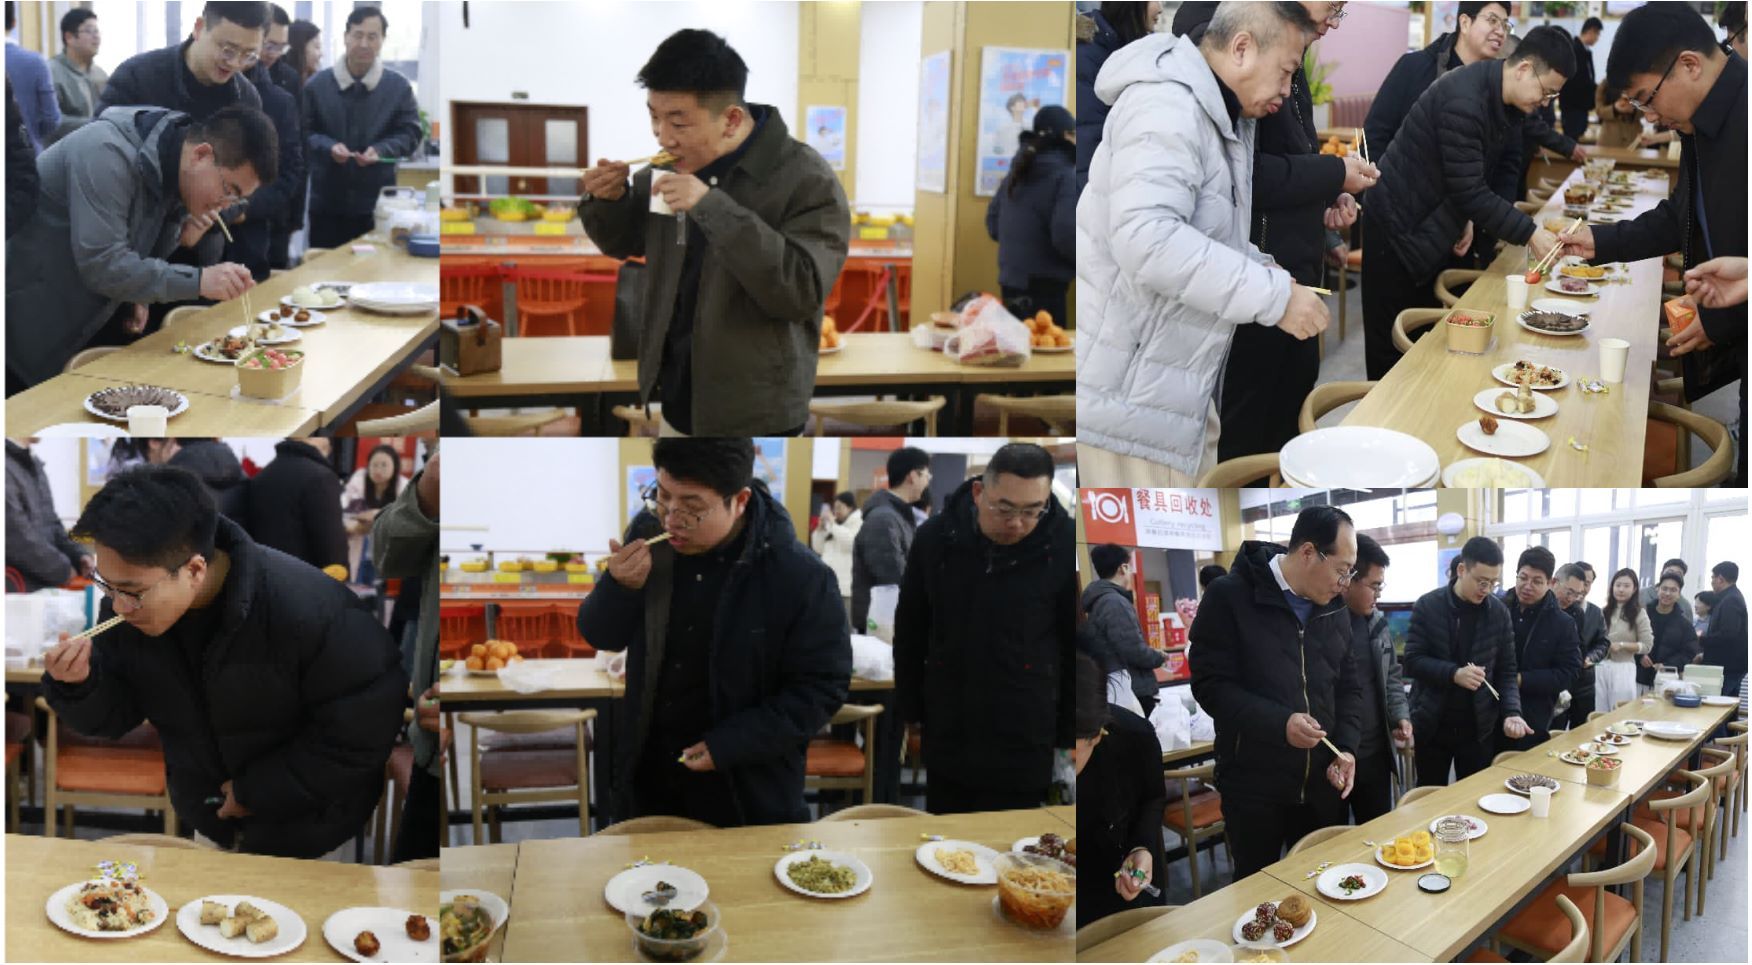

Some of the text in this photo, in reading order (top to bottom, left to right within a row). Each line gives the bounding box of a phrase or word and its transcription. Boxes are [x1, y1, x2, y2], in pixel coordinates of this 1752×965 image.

[1137, 488, 1212, 517] 餐具回收处
